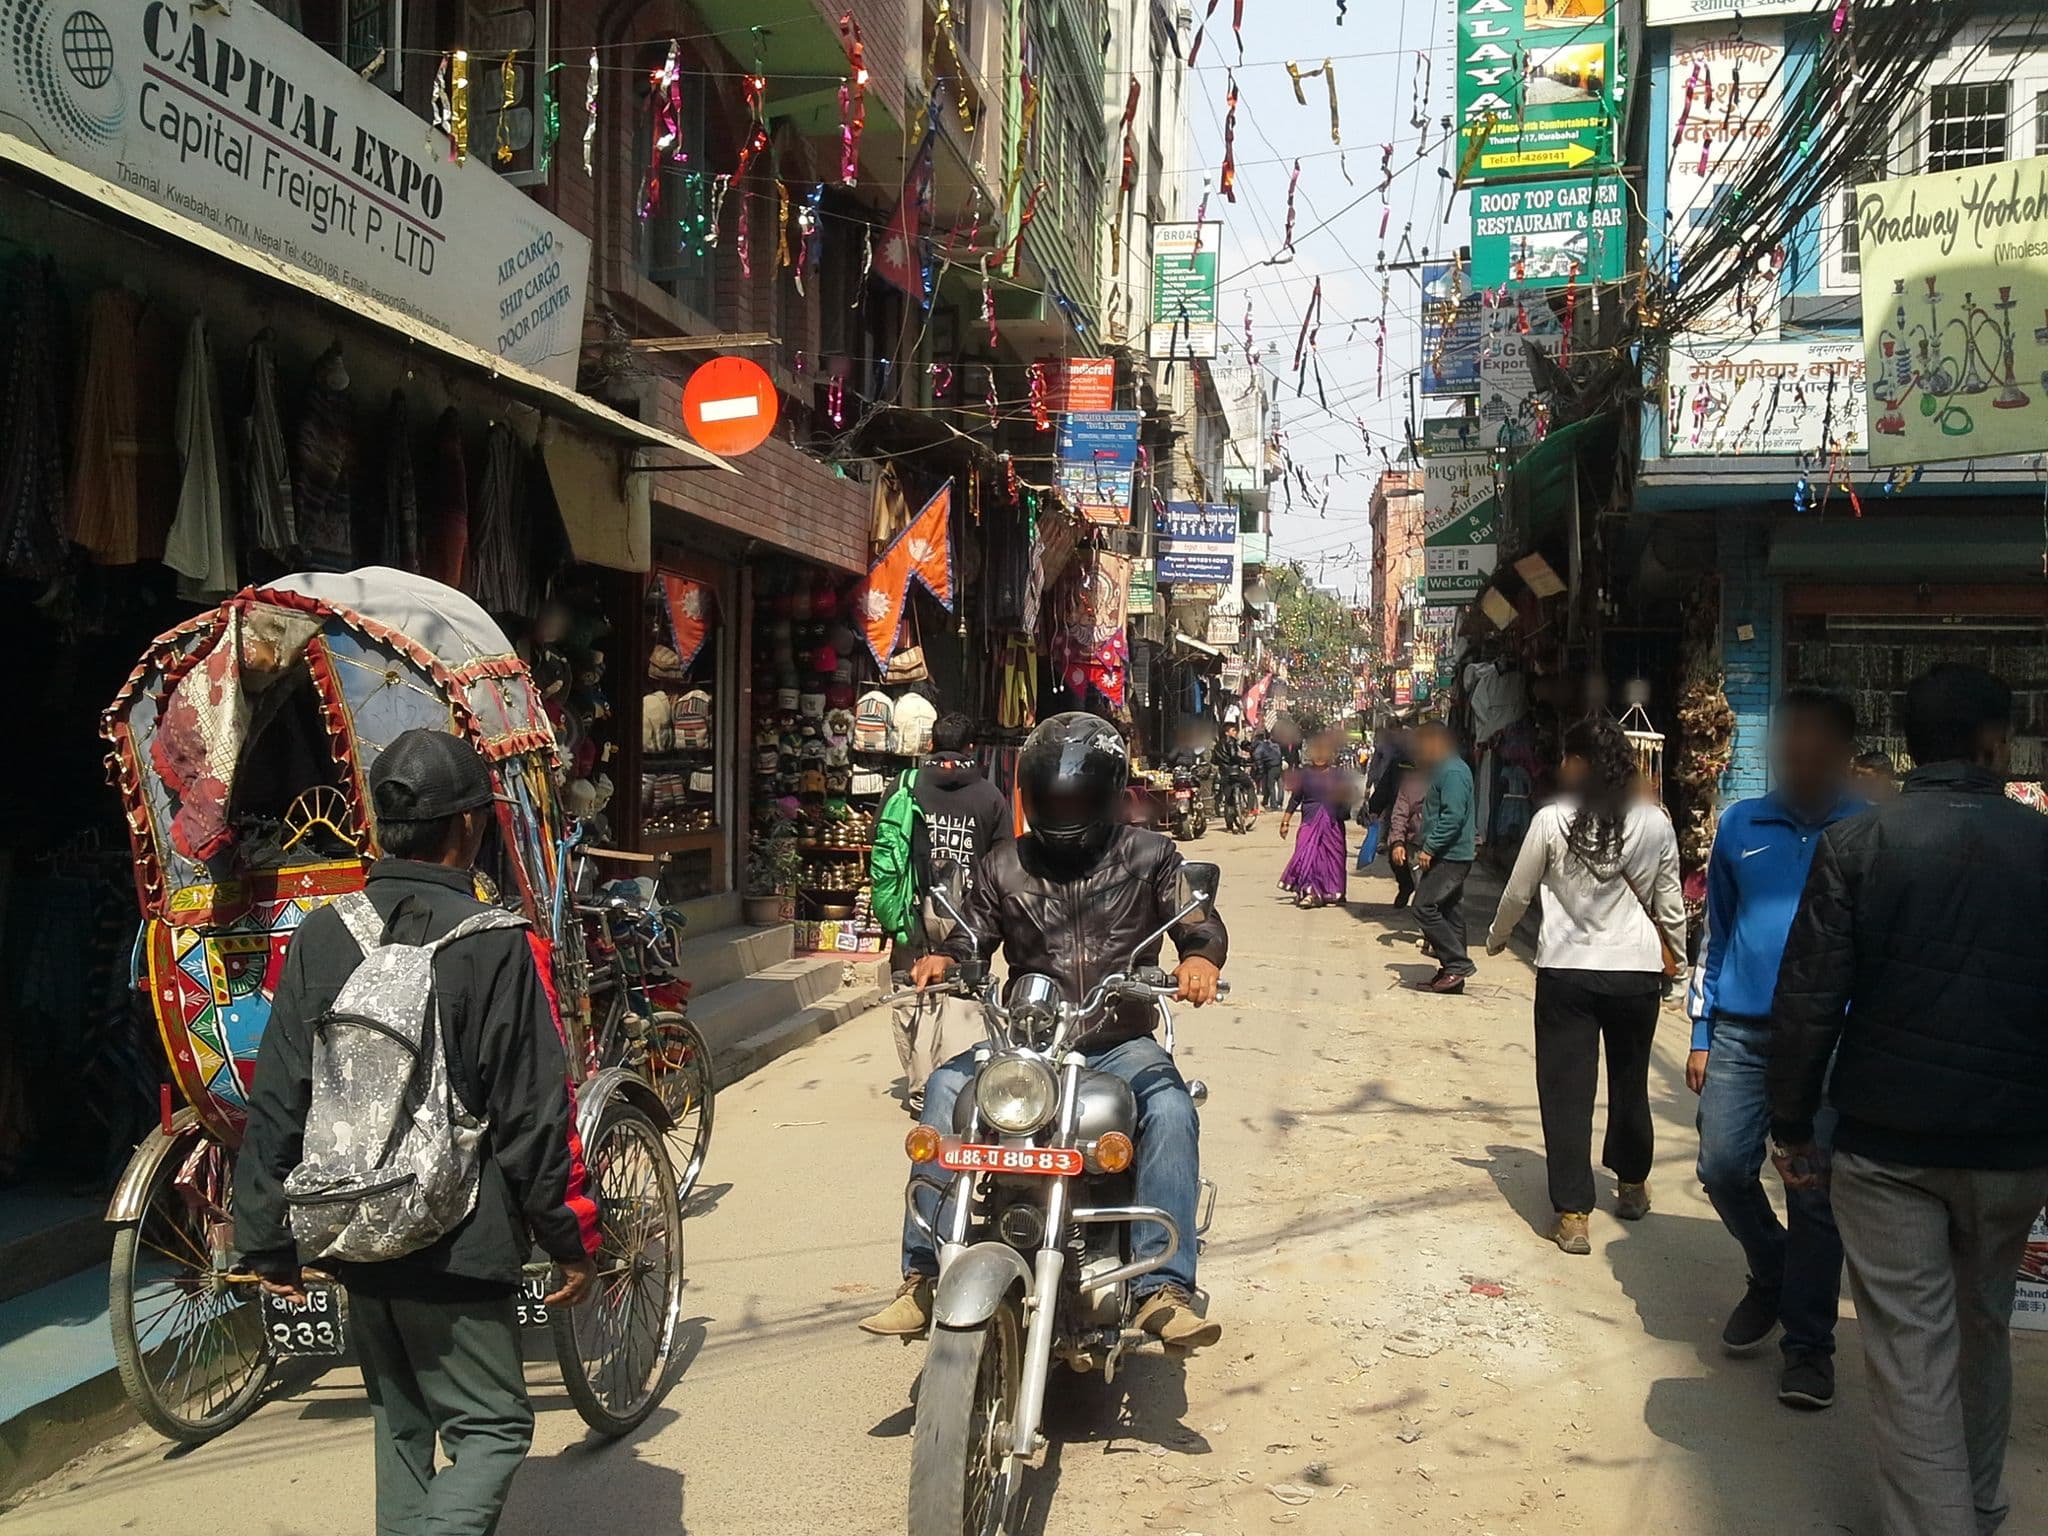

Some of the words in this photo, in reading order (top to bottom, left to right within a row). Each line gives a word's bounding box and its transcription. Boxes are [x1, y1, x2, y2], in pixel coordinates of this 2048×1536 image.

[143, 1, 342, 163] CAPITAL
[351, 125, 443, 220] EXPO
[116, 161, 161, 195] Thamal
[253, 226, 283, 252] Nepal
[139, 82, 252, 181] Capital
[262, 146, 357, 236] Freight
[394, 221, 435, 276] LTD
[1480, 192, 1521, 213] ROOF
[1524, 189, 1554, 210] TOP
[1477, 211, 1572, 236] RESTAURANT
[1576, 210, 1588, 229] &
[1592, 207, 1622, 228] BAR
[1859, 189, 1959, 256] Roadway
[1960, 168, 2048, 249] Hookah
[498, 257, 517, 286] AIR
[517, 230, 553, 269] CARGO
[497, 316, 532, 355] DOOR
[531, 284, 572, 329] DELIVER
[500, 288, 523, 321] SHIP
[524, 260, 560, 300] CARGO
[1427, 485, 1493, 533] Restaurant
[1469, 516, 1480, 526] &
[1469, 522, 1493, 544] Bar
